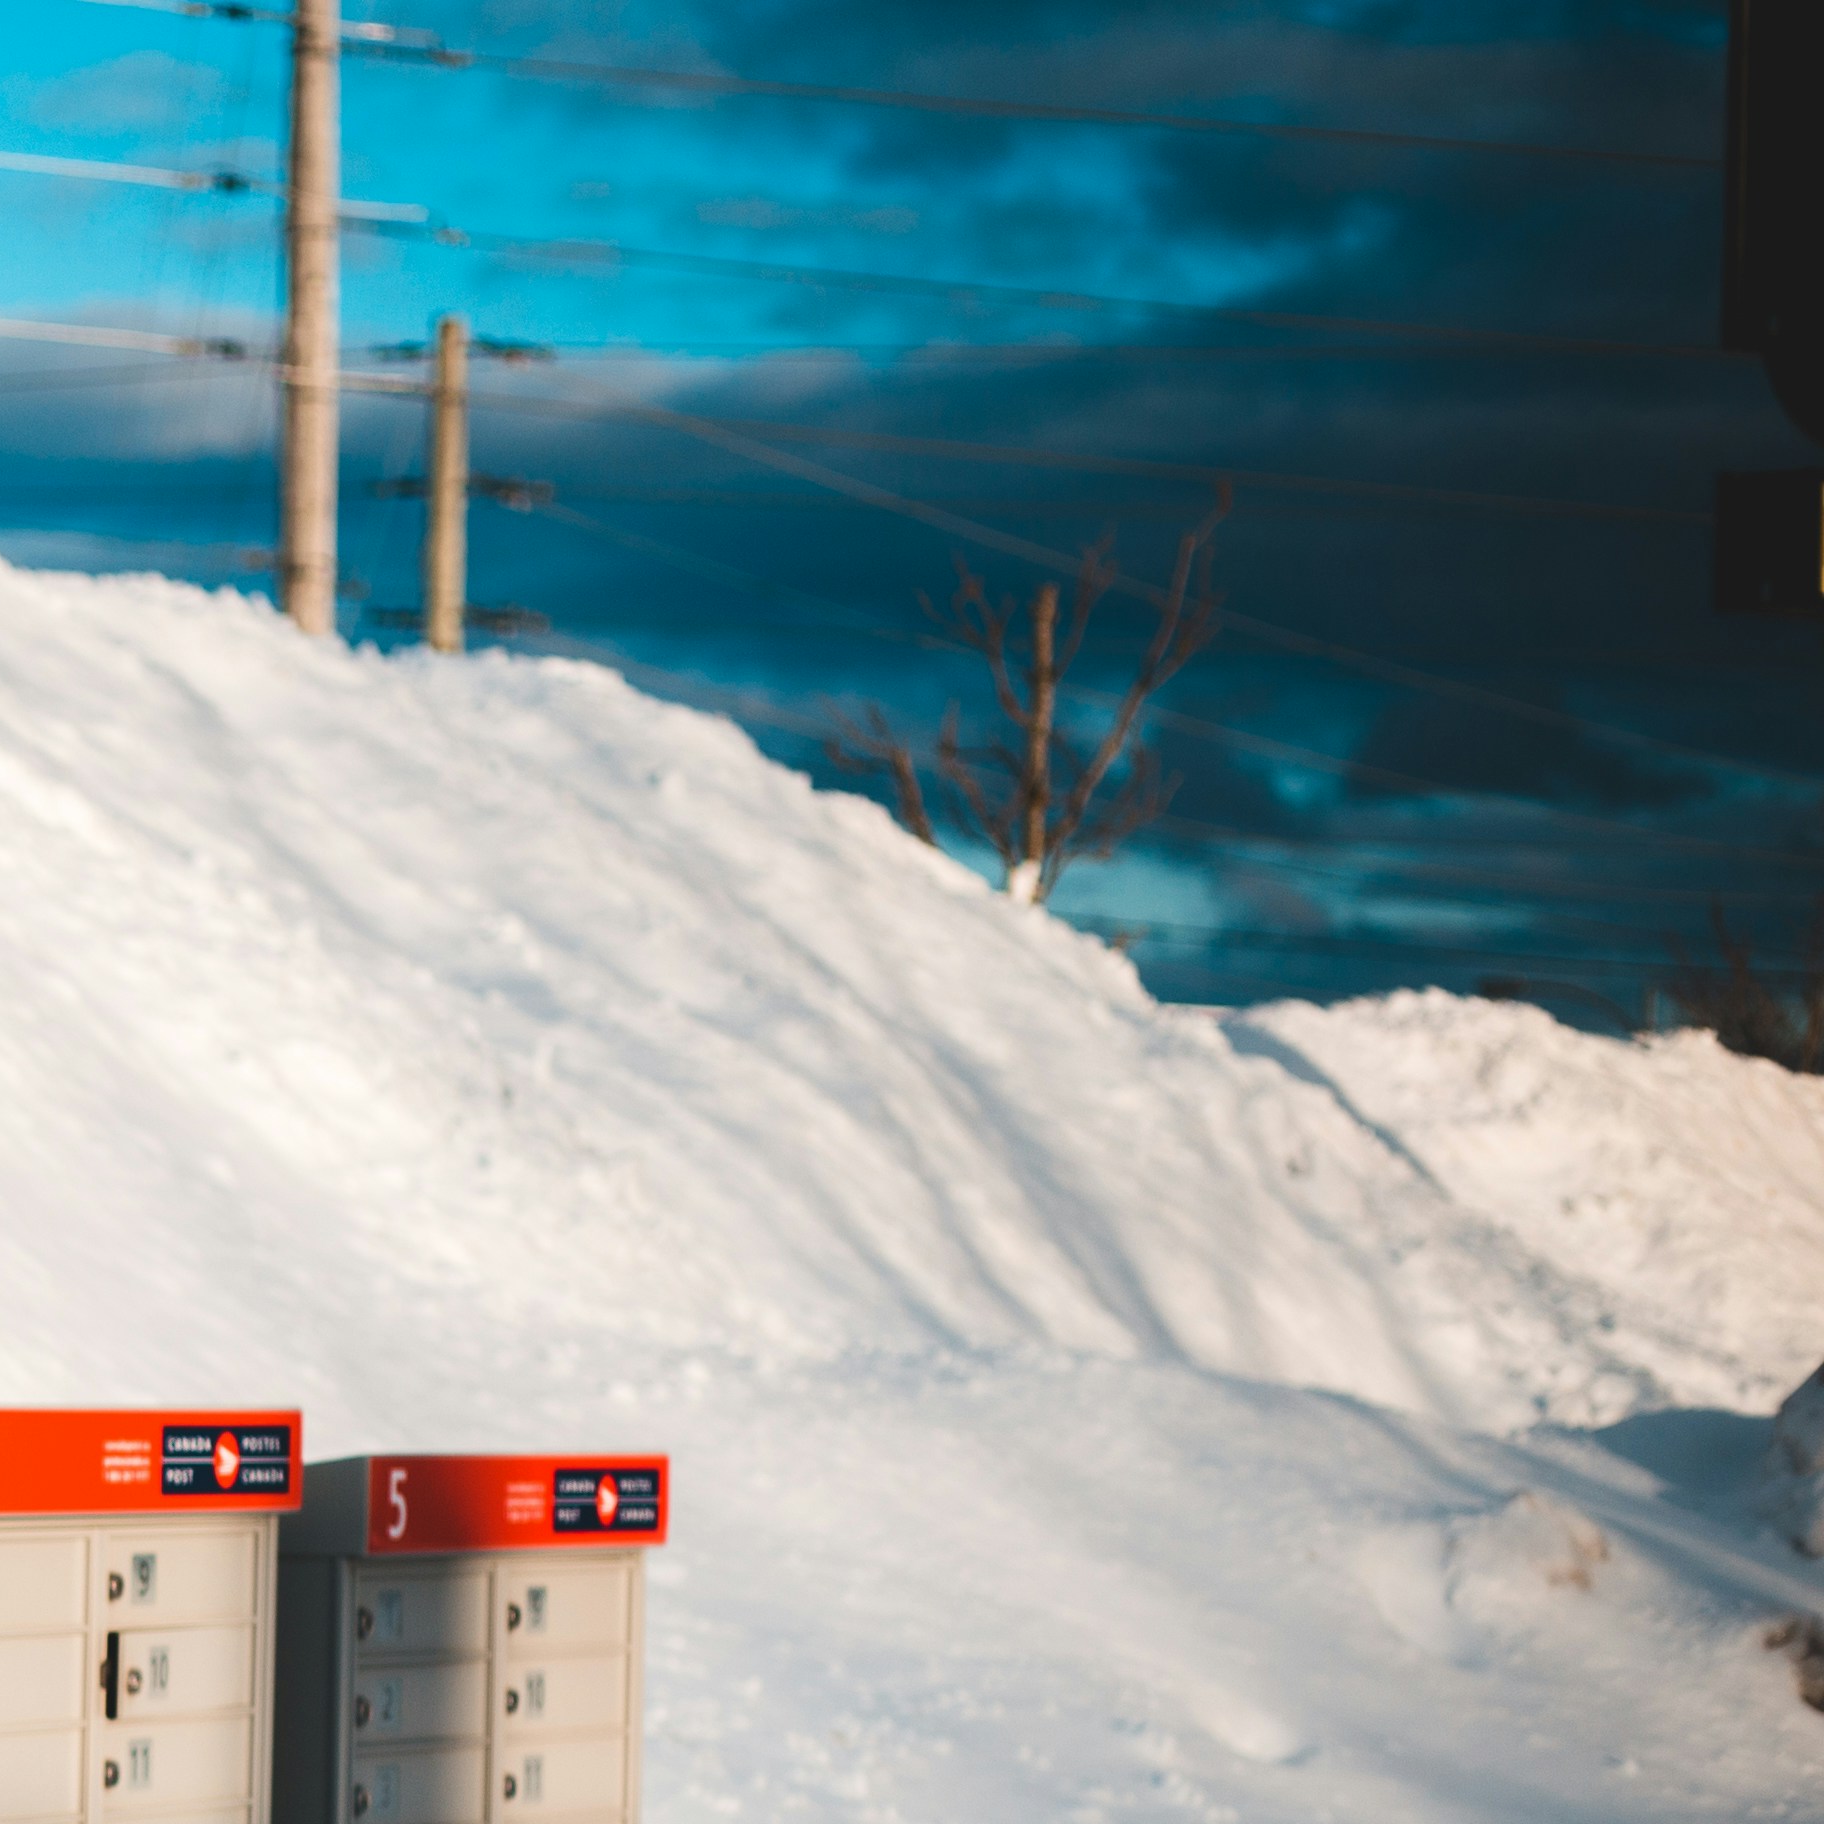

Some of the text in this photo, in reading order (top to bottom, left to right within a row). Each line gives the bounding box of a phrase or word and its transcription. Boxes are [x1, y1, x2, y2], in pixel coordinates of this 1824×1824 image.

[388, 1468, 407, 1538] 5
[138, 1560, 151, 1597] 9
[151, 1653, 169, 1689] 10
[131, 1747, 149, 1782] 11
